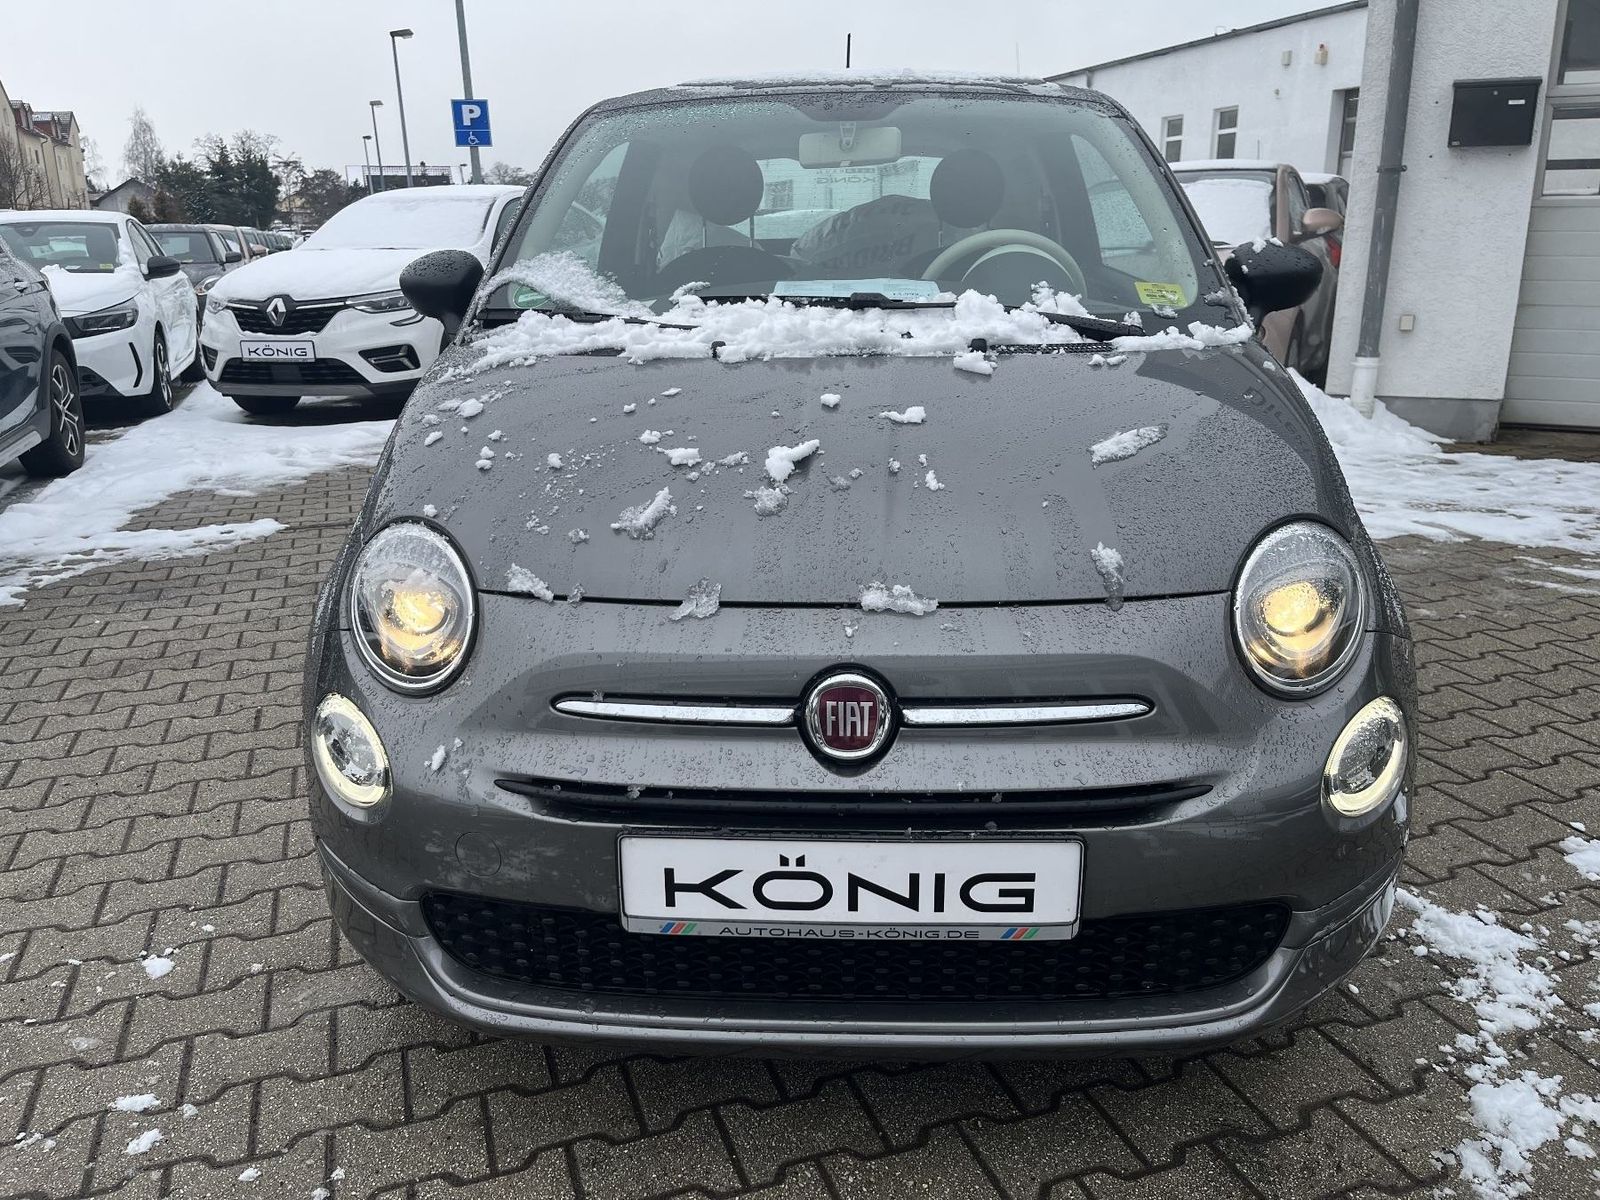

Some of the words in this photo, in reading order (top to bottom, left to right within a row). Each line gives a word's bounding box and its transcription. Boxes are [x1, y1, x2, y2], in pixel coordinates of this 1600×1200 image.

[461, 104, 482, 126] P
[247, 344, 308, 357] KÖNIG
[826, 701, 874, 737] FIAT
[663, 854, 1036, 913] KÖNIG
[719, 926, 980, 940] AUTOHAUS-KÖNIG.DE
